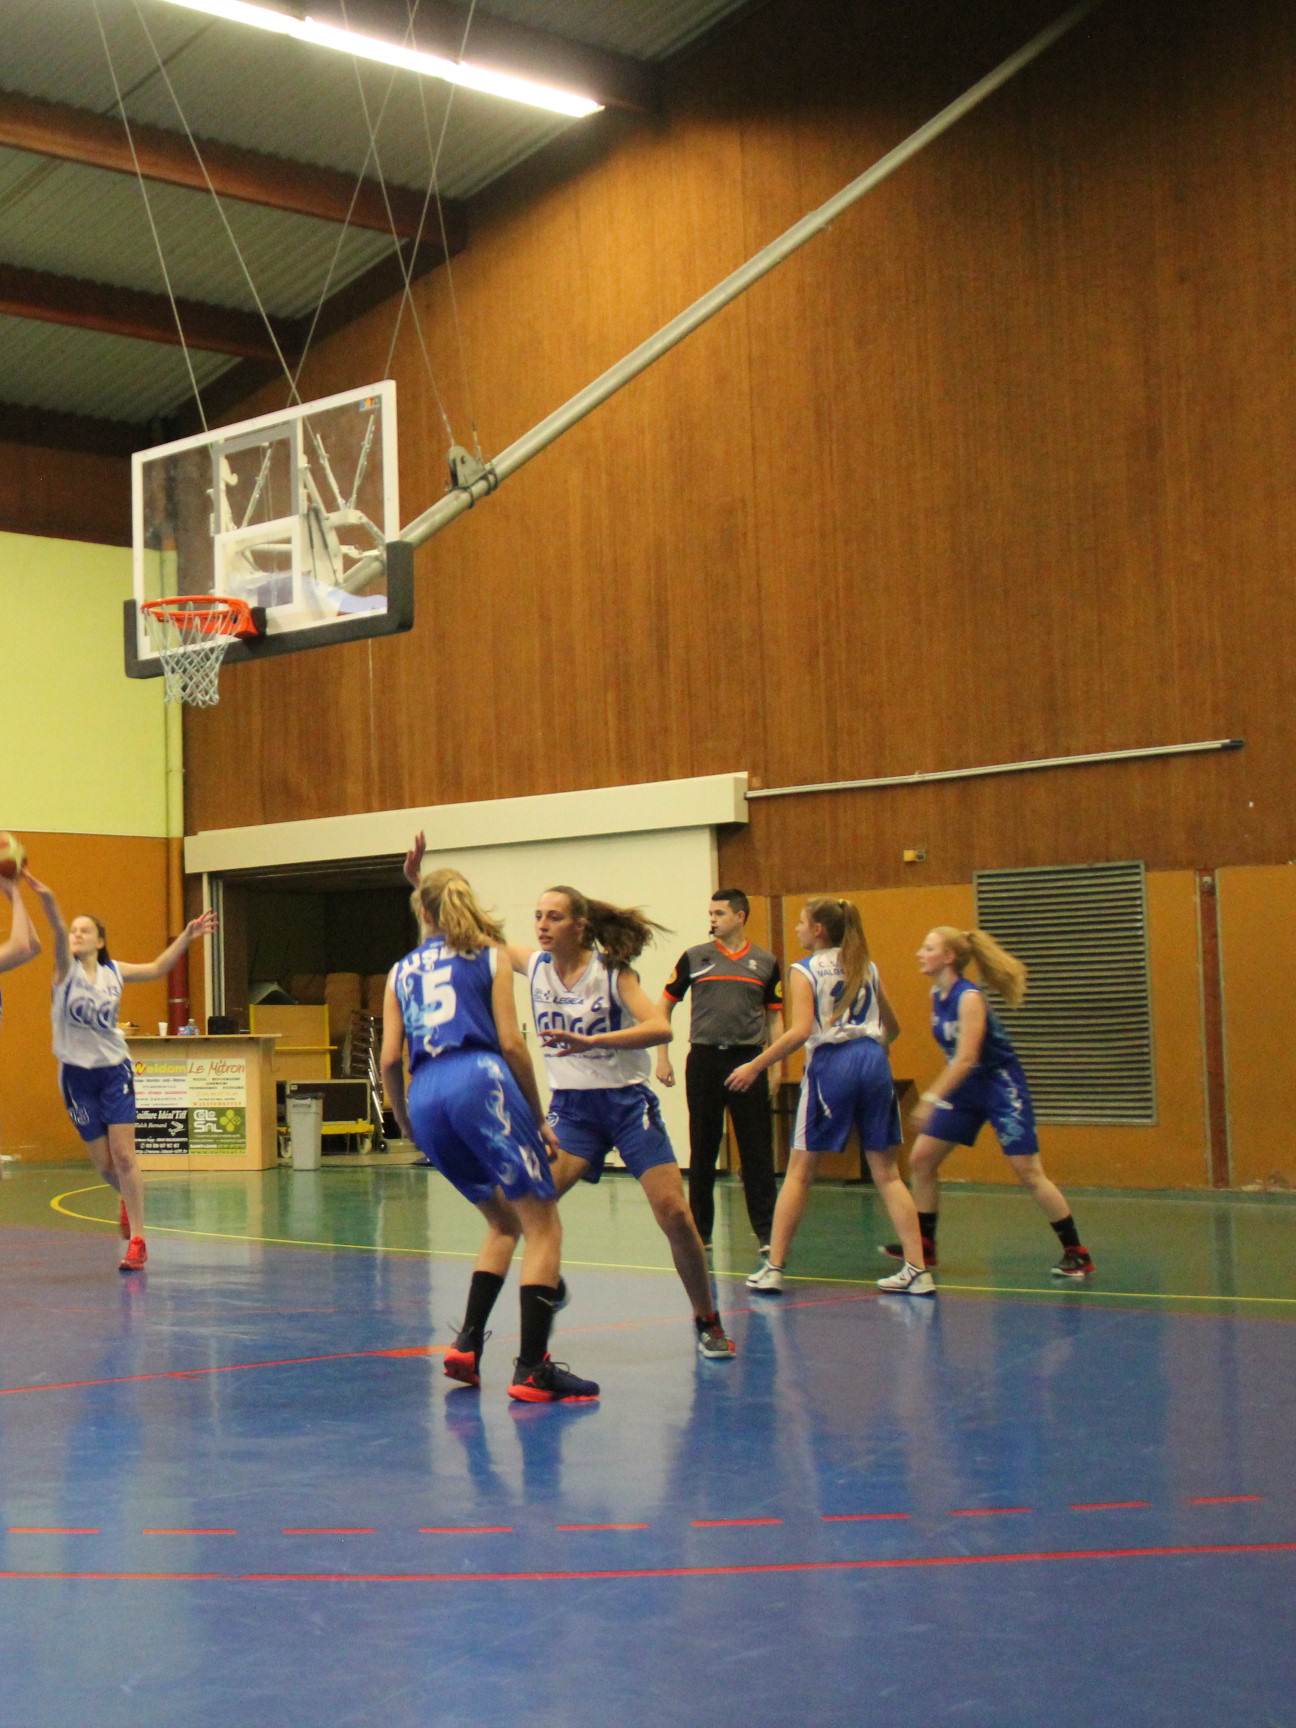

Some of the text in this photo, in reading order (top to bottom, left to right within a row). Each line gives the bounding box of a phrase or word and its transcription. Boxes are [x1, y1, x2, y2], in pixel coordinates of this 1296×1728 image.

[421, 965, 457, 1028] 5
[591, 996, 605, 1012] 6
[188, 1062, 205, 1074] Le
[135, 1110, 158, 1120] oiffure
